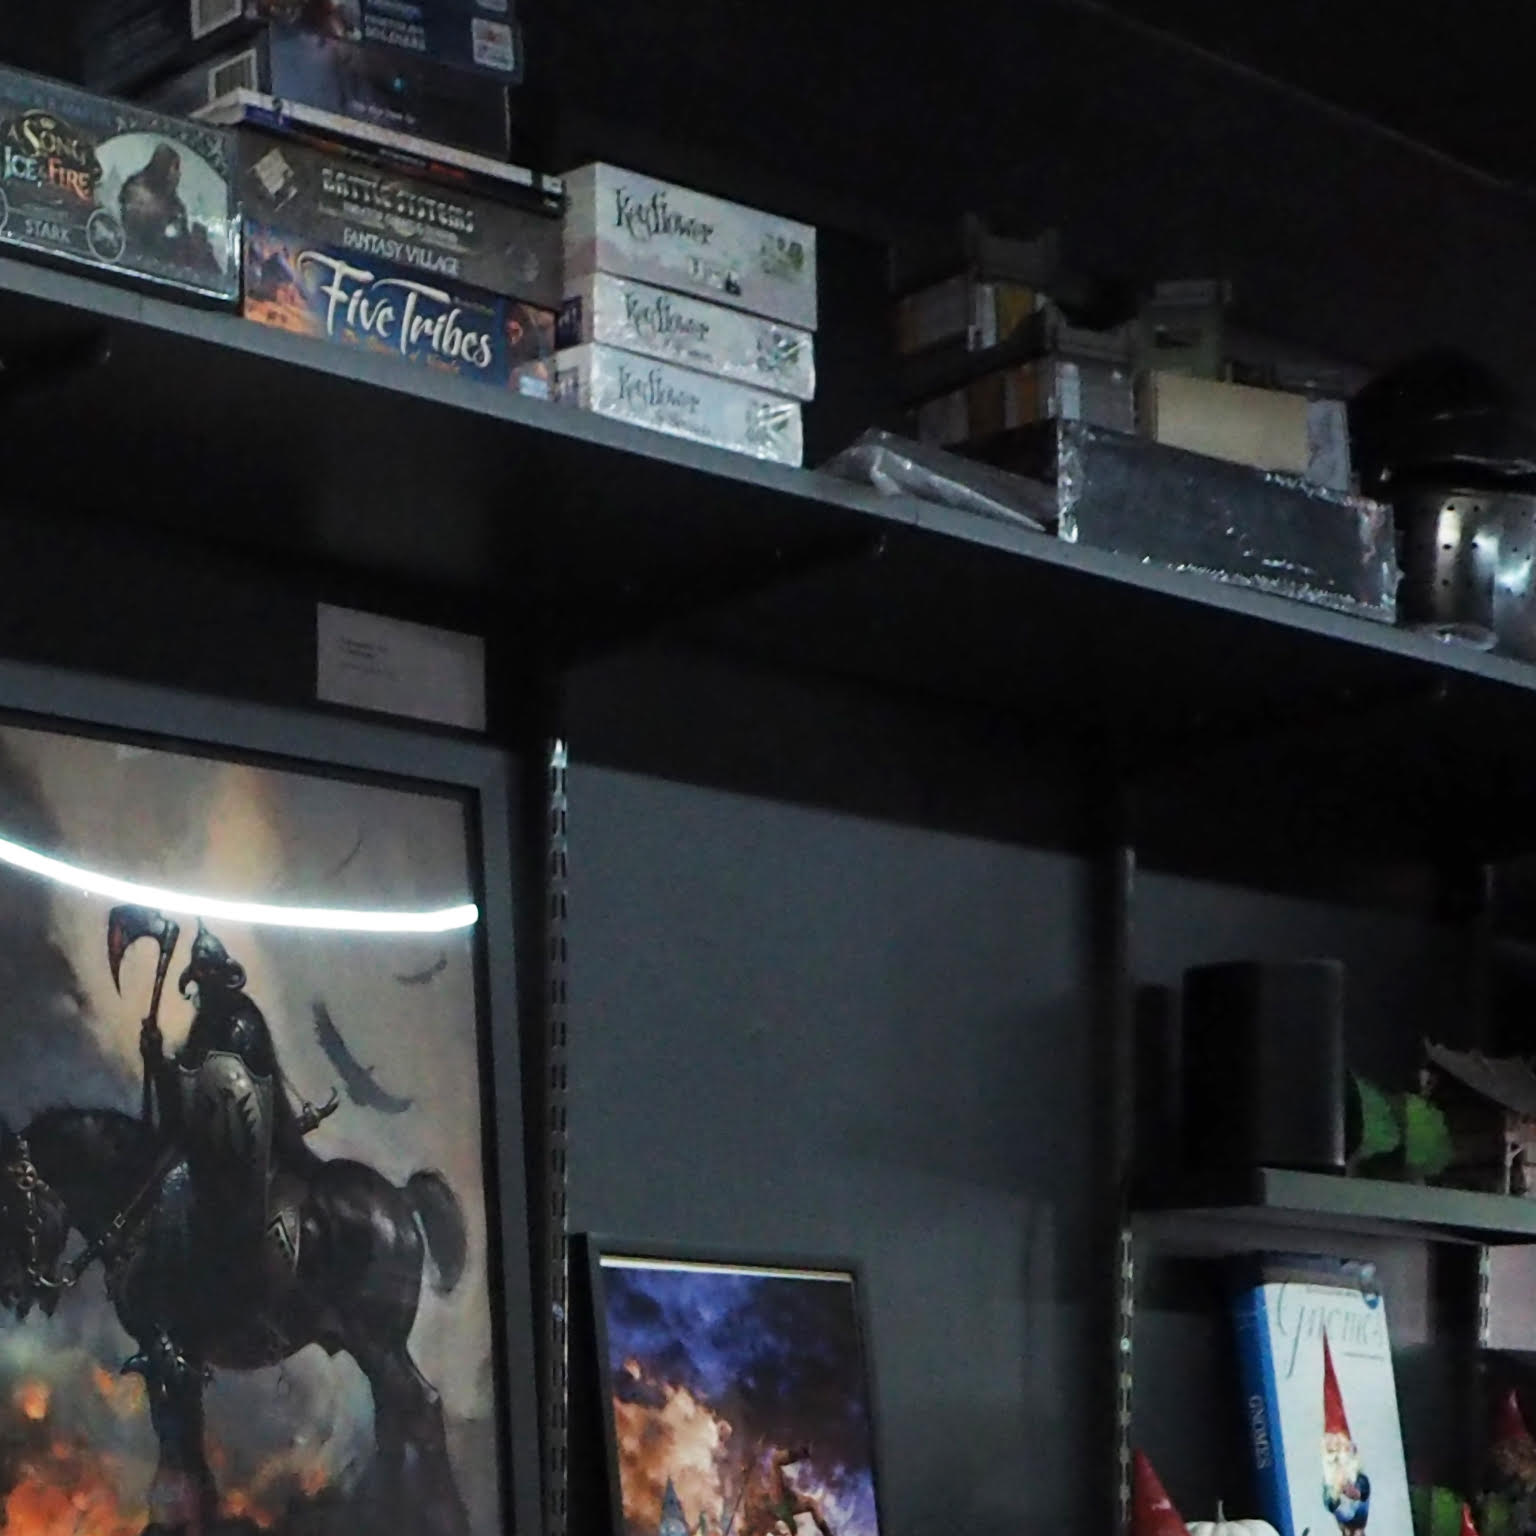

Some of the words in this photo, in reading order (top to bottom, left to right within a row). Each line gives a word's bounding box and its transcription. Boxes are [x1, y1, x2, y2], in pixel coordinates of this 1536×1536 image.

[342, 229, 403, 260] FANTASY
[404, 246, 461, 277] VILLAGE
[1248, 1394, 1271, 1470] GNOMES
